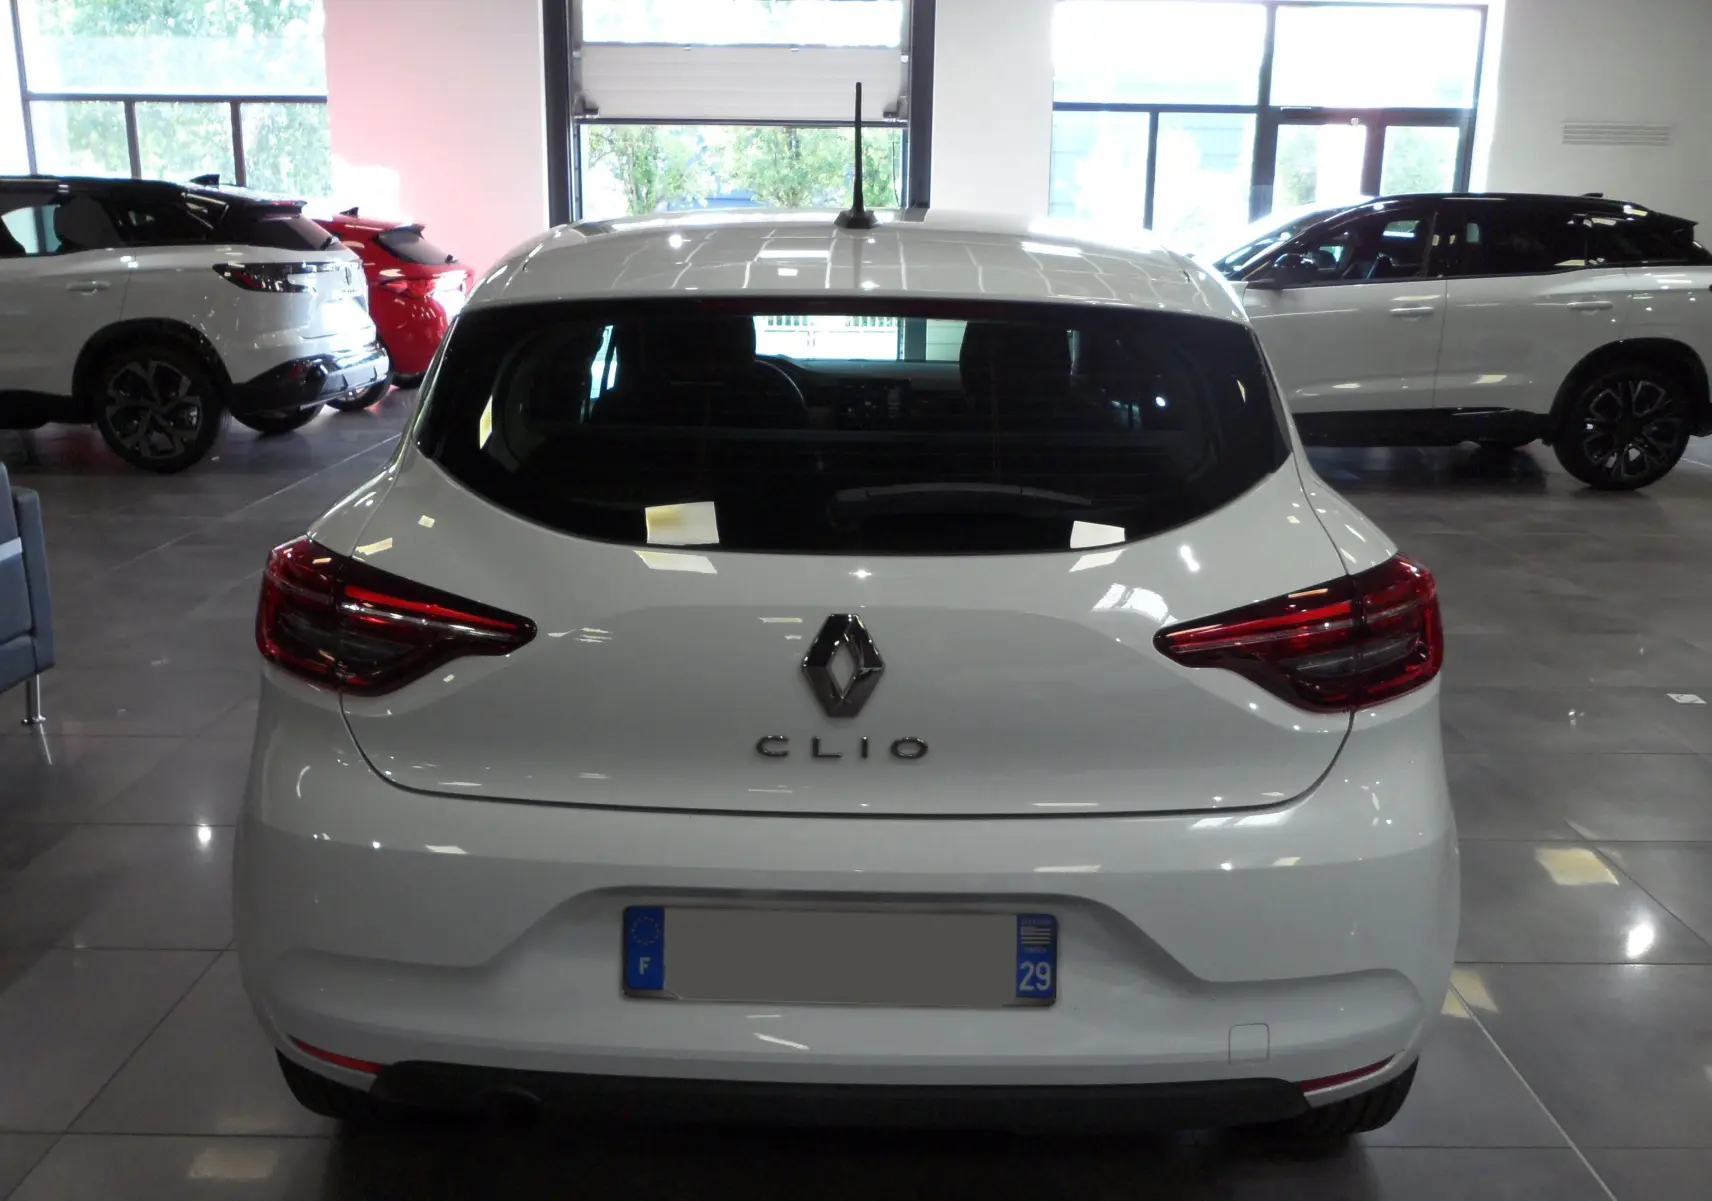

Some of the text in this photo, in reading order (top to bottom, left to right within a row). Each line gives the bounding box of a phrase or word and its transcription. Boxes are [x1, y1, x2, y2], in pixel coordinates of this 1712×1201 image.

[755, 735, 929, 759] CLIO
[639, 956, 652, 976] F
[1019, 960, 1051, 991] 29
